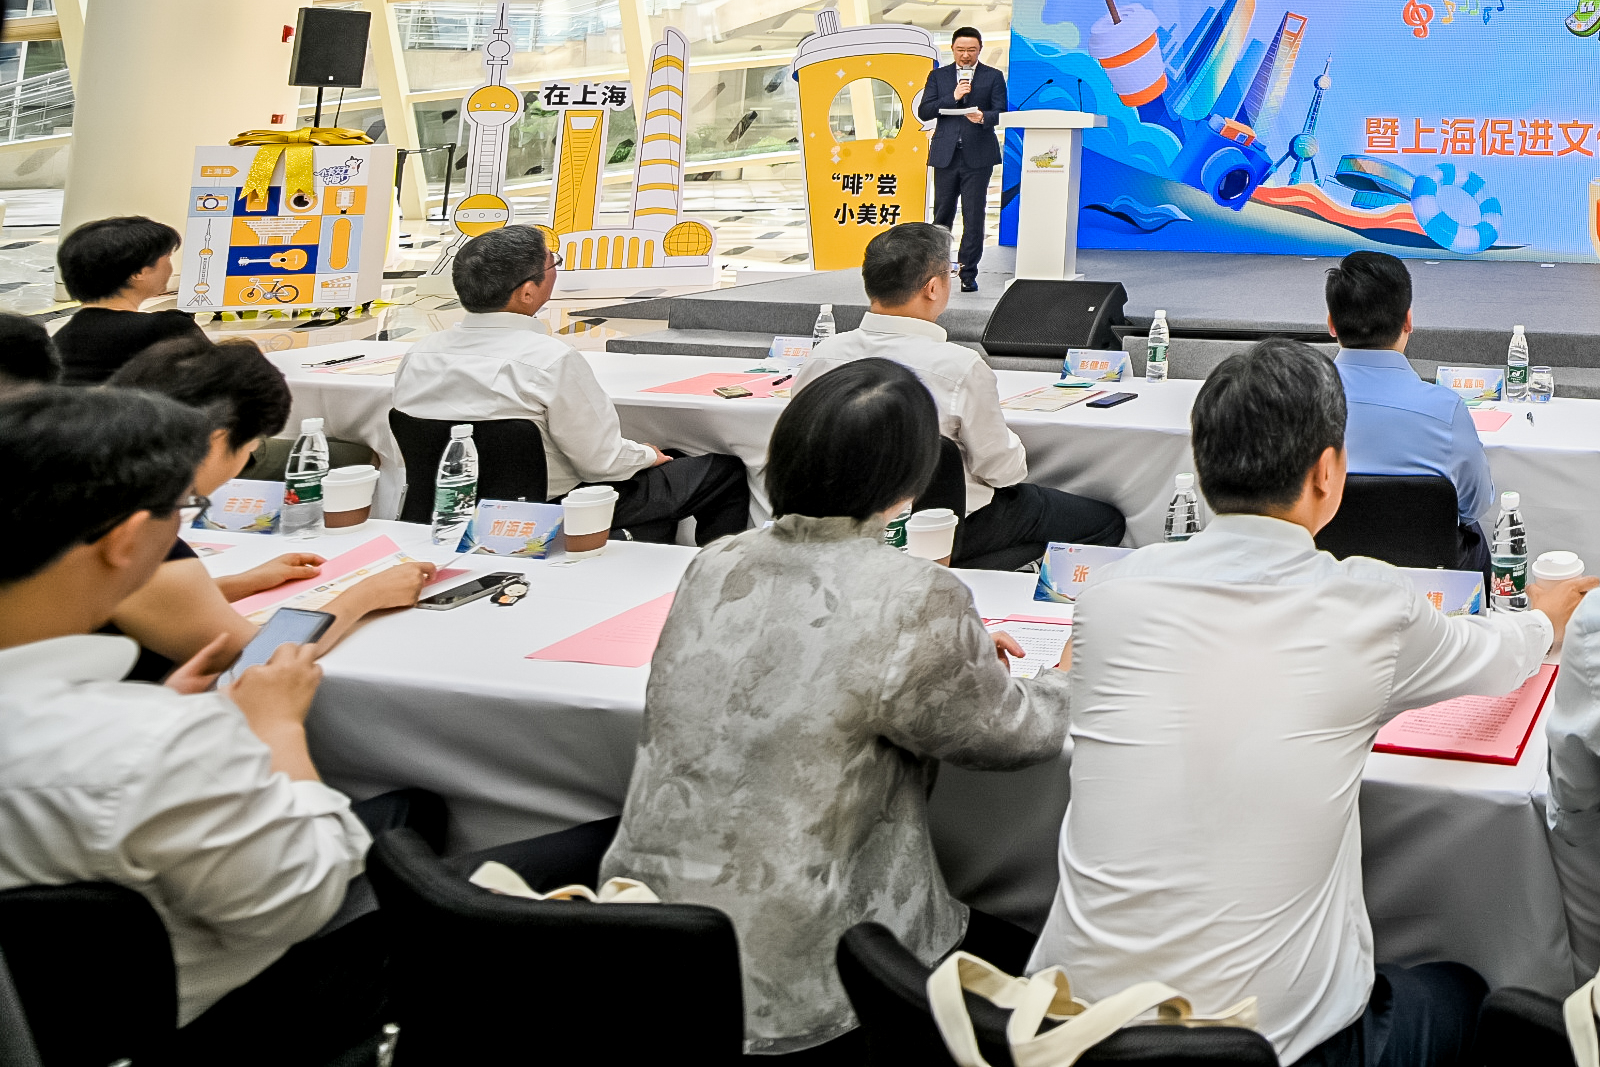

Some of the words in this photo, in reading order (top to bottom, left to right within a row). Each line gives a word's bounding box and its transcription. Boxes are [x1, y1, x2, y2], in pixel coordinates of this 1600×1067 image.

[543, 84, 628, 108] 在上海
[204, 168, 232, 176] 上海站
[831, 173, 898, 196] “啡”尝
[834, 201, 902, 226] 小美好
